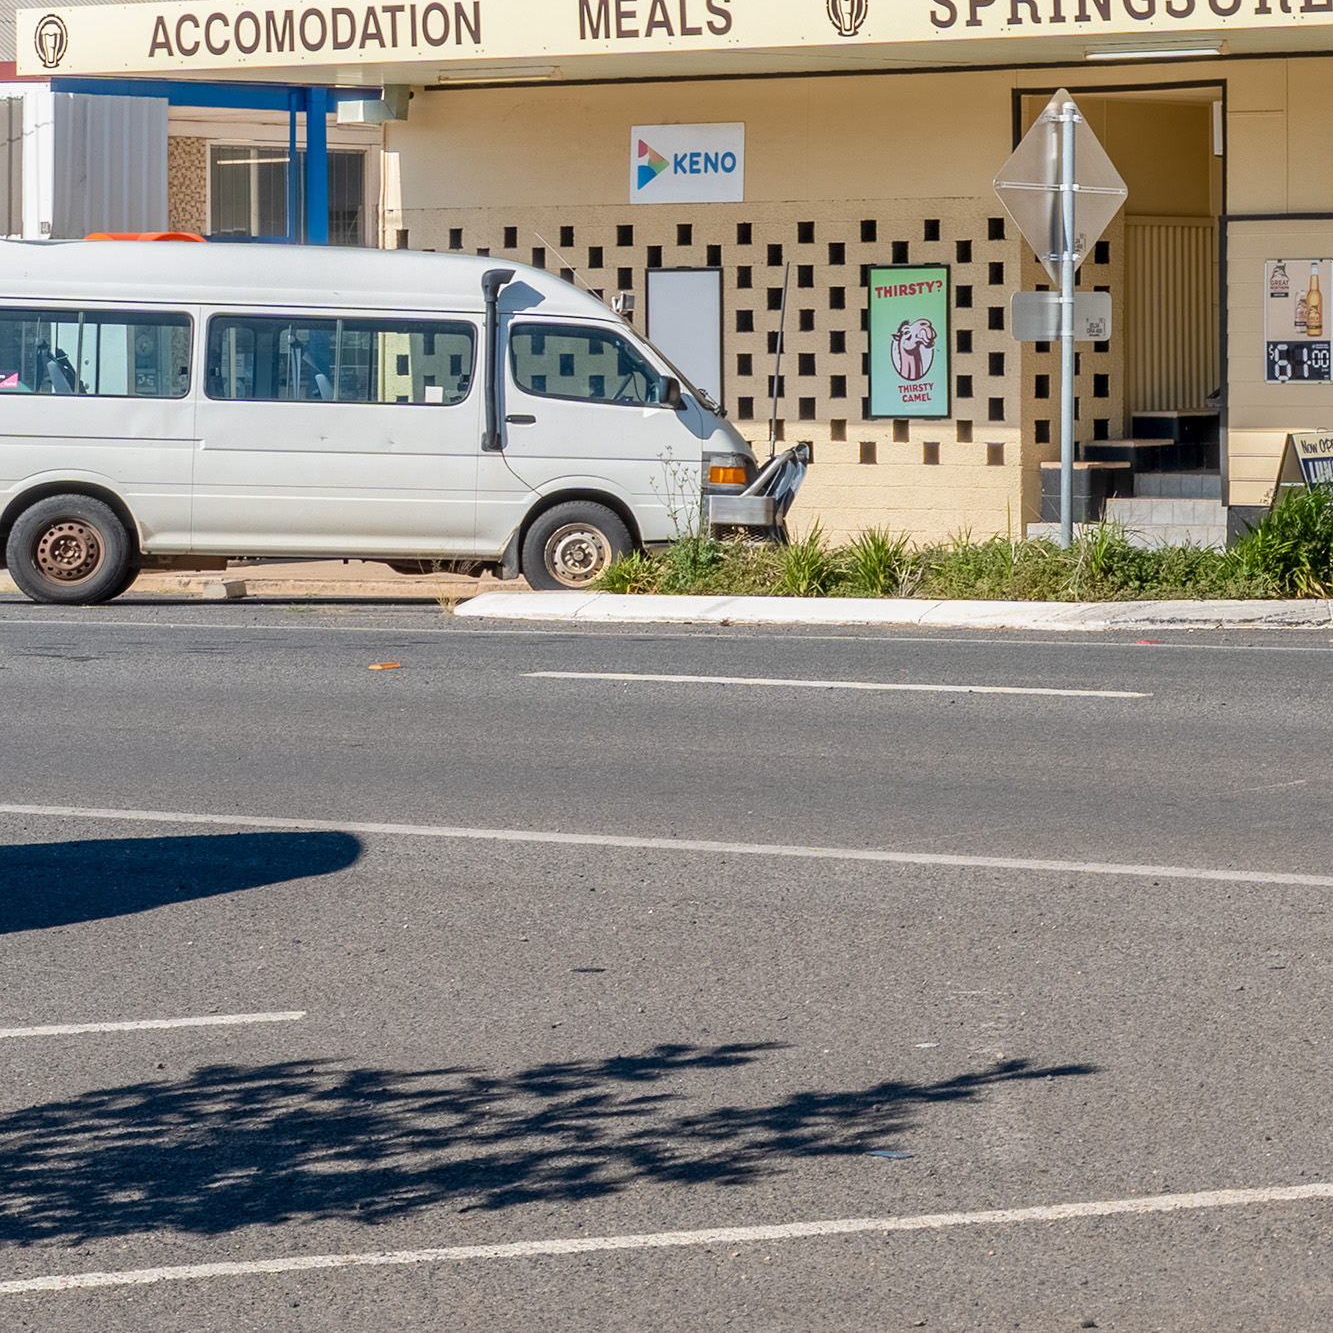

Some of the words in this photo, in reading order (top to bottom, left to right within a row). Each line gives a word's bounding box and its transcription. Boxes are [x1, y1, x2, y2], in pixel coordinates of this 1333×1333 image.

[148, 1, 482, 58] ACCOMODATION
[673, 151, 736, 175] KENO
[874, 280, 943, 299] THIRSTY?
[897, 382, 934, 394] THIRSTY
[902, 392, 932, 403] CAMEL
[1300, 440, 1318, 454] Now
